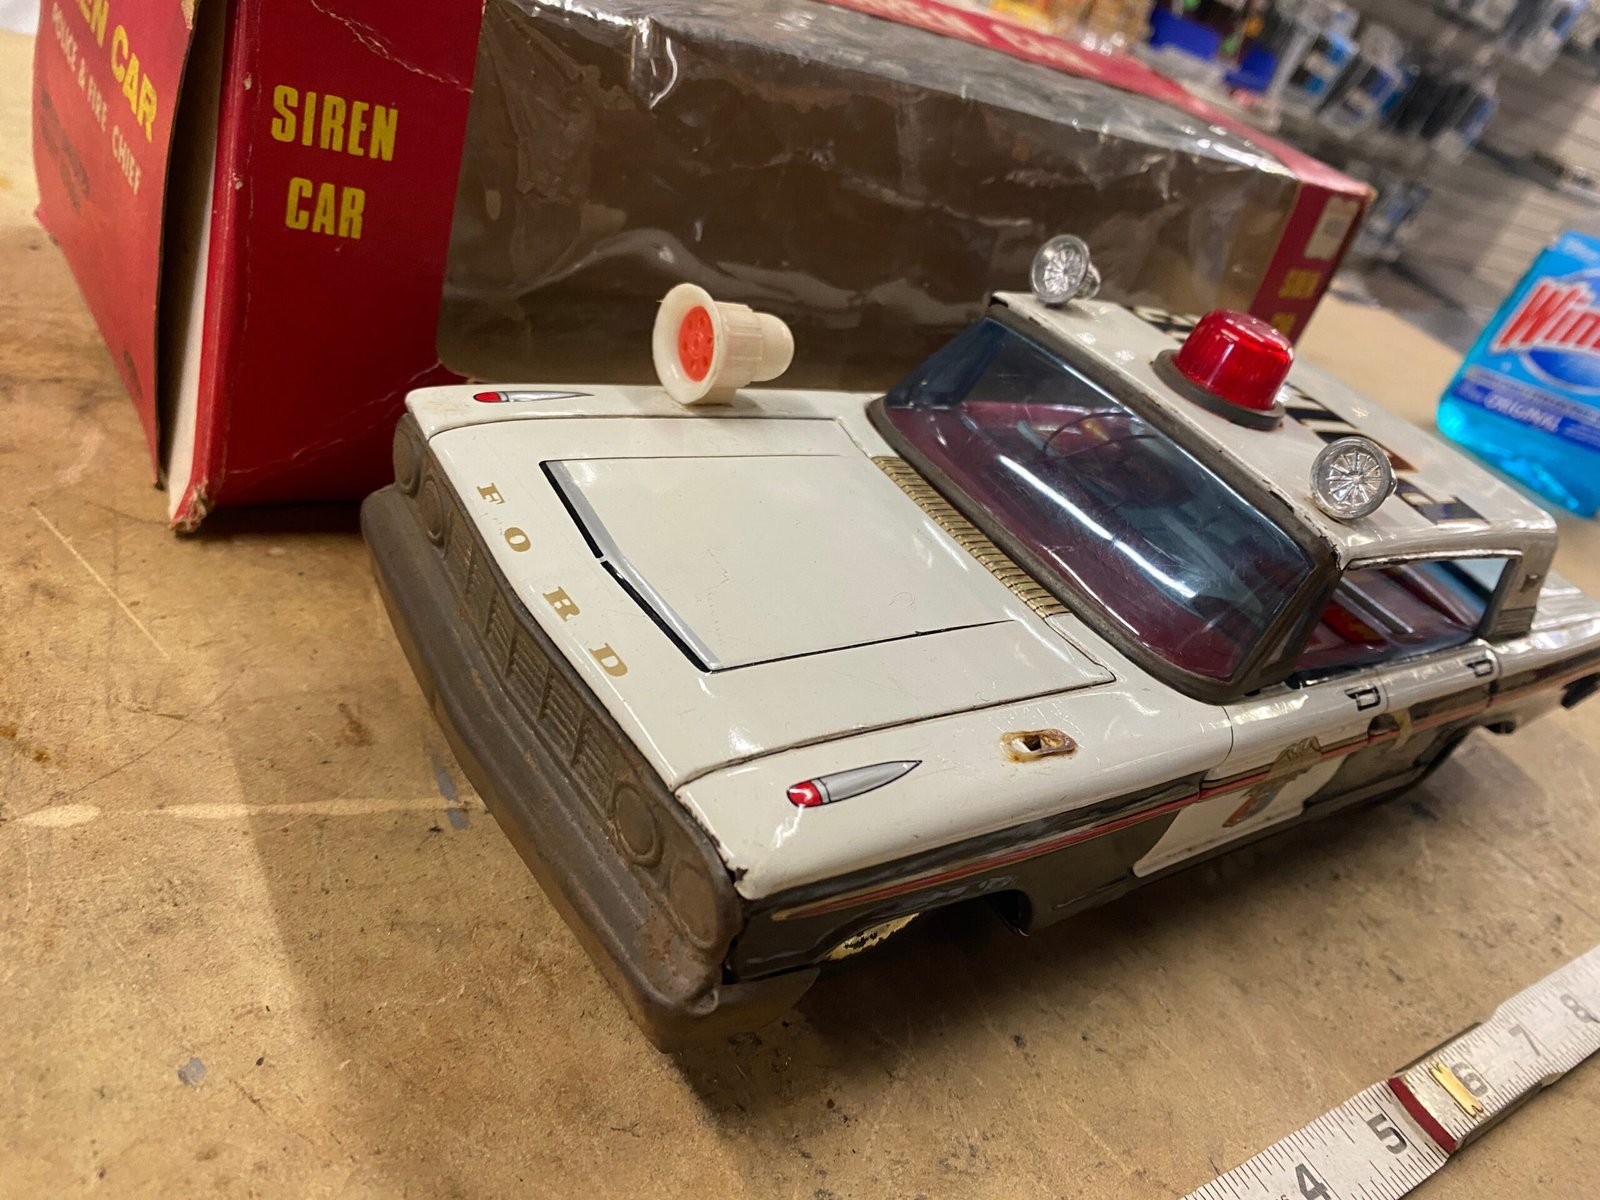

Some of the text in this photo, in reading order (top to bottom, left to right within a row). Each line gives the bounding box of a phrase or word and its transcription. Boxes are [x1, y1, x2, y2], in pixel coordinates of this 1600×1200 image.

[111, 24, 157, 143] CAR
[112, 125, 141, 196] CHIEF
[271, 85, 398, 161] SIREN
[285, 177, 366, 239] CAR
[1496, 280, 1600, 350] Win
[477, 483, 628, 677] FORD
[1295, 993, 1593, 1200] 4 5 6 7 8
